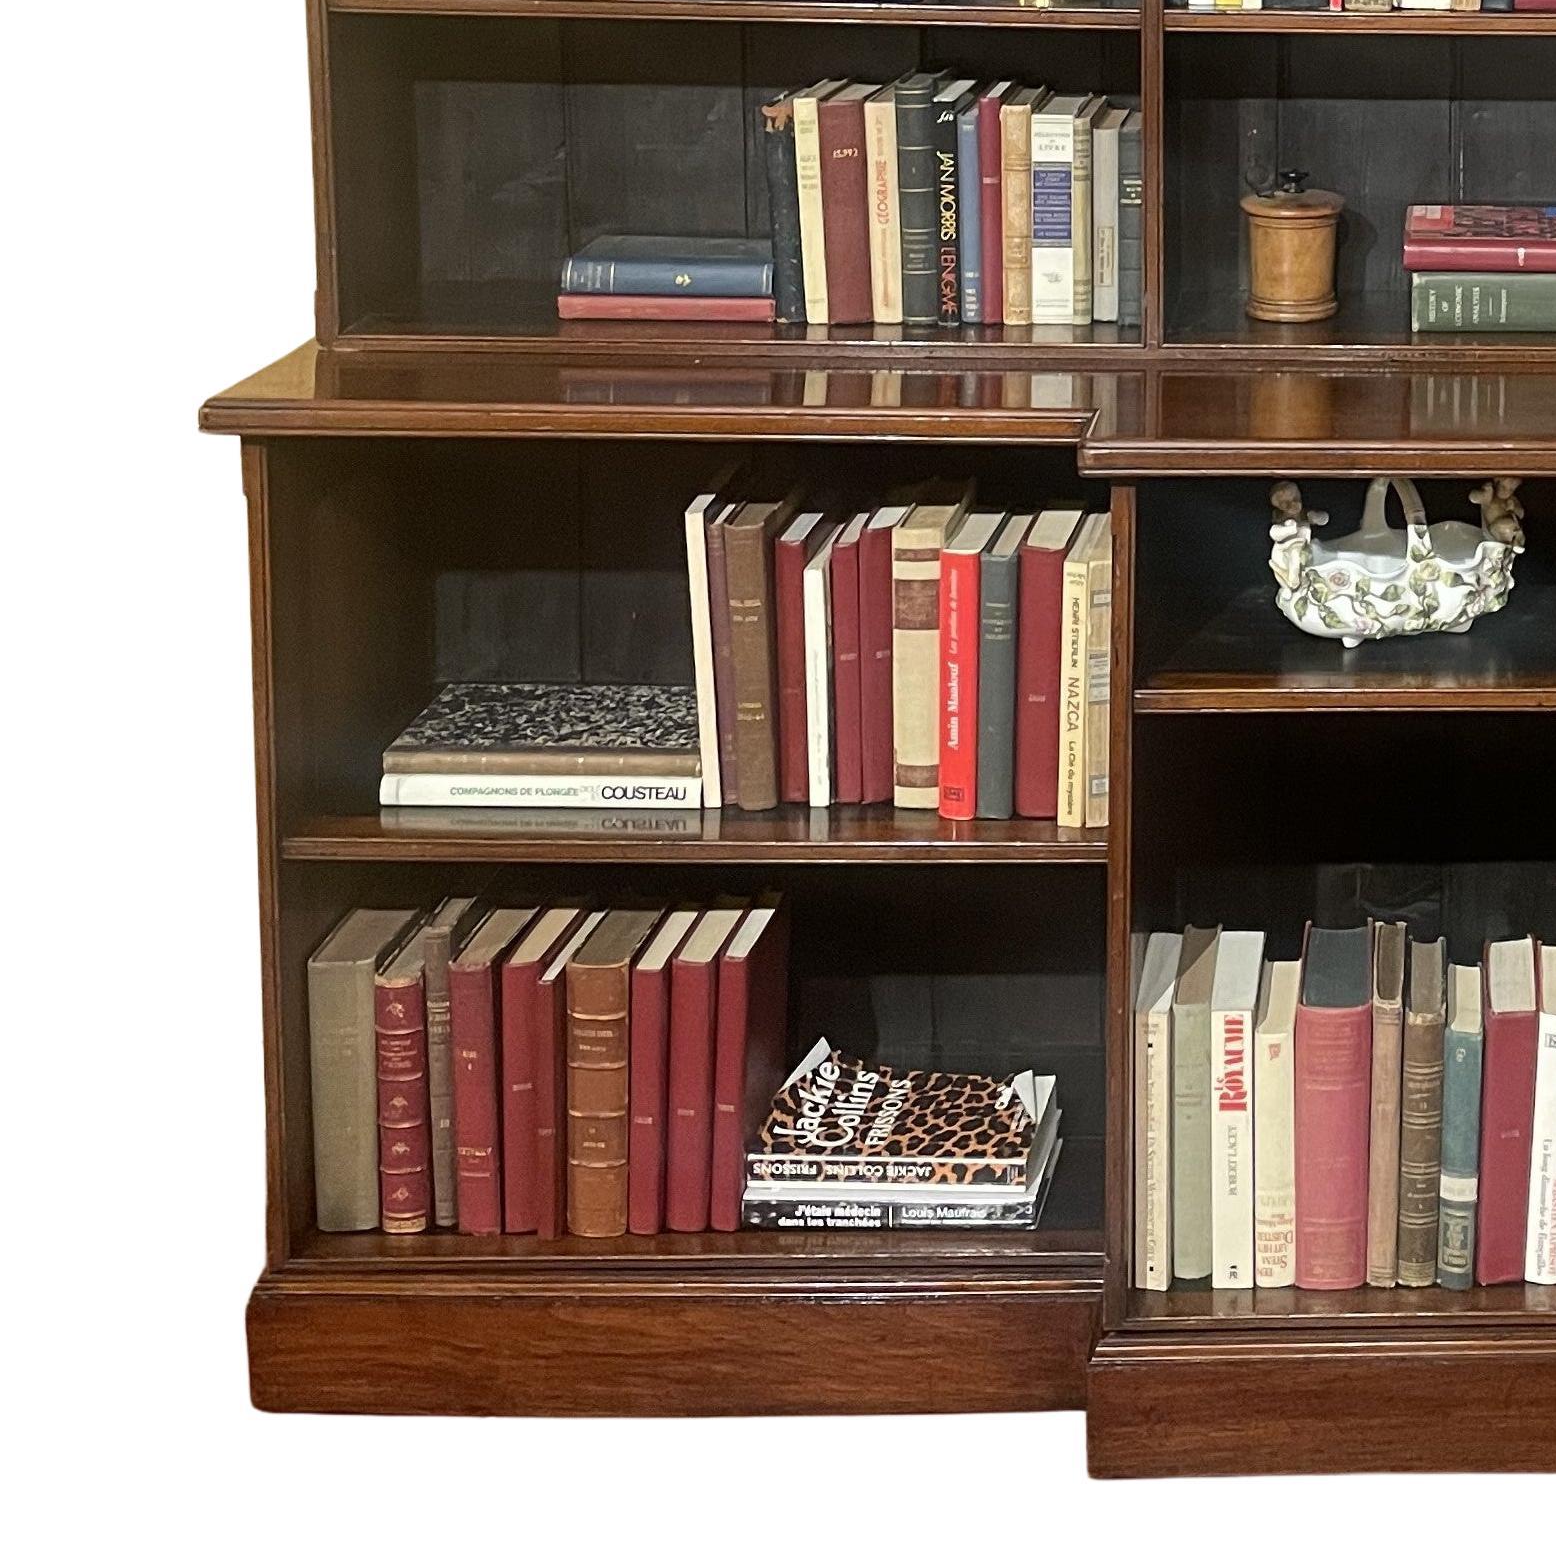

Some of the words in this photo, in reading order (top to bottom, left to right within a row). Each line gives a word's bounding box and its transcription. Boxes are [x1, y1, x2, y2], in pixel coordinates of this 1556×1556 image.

[936, 150, 955, 181] JAN
[939, 184, 956, 240] MORRIS
[1072, 597, 1080, 625] HENRI
[946, 661, 959, 713] Maalouf
[1066, 677, 1080, 732] NAZCA
[947, 716, 959, 750] Amin
[450, 786, 518, 796] COMPAGNONS
[519, 787, 532, 796] DE
[535, 786, 580, 797] PLONGÉE
[601, 786, 687, 801] COUSTEAU
[1218, 1013, 1247, 1112] ROYAUME
[772, 1061, 841, 1145] Jackie
[812, 1069, 879, 1147] Collins
[864, 1078, 912, 1146] FRISSONS
[1227, 1124, 1237, 1157] LACEY
[753, 1163, 818, 1176] FRISSONS
[825, 1165, 885, 1178] COLLINS
[887, 1165, 933, 1178] JACKIE
[1227, 1160, 1238, 1196] ROBERT
[778, 1217, 801, 1227] dans
[806, 1216, 824, 1227] les
[794, 1204, 833, 1217] J'étais
[834, 1204, 881, 1217] médecin
[902, 1206, 934, 1219] Louis
